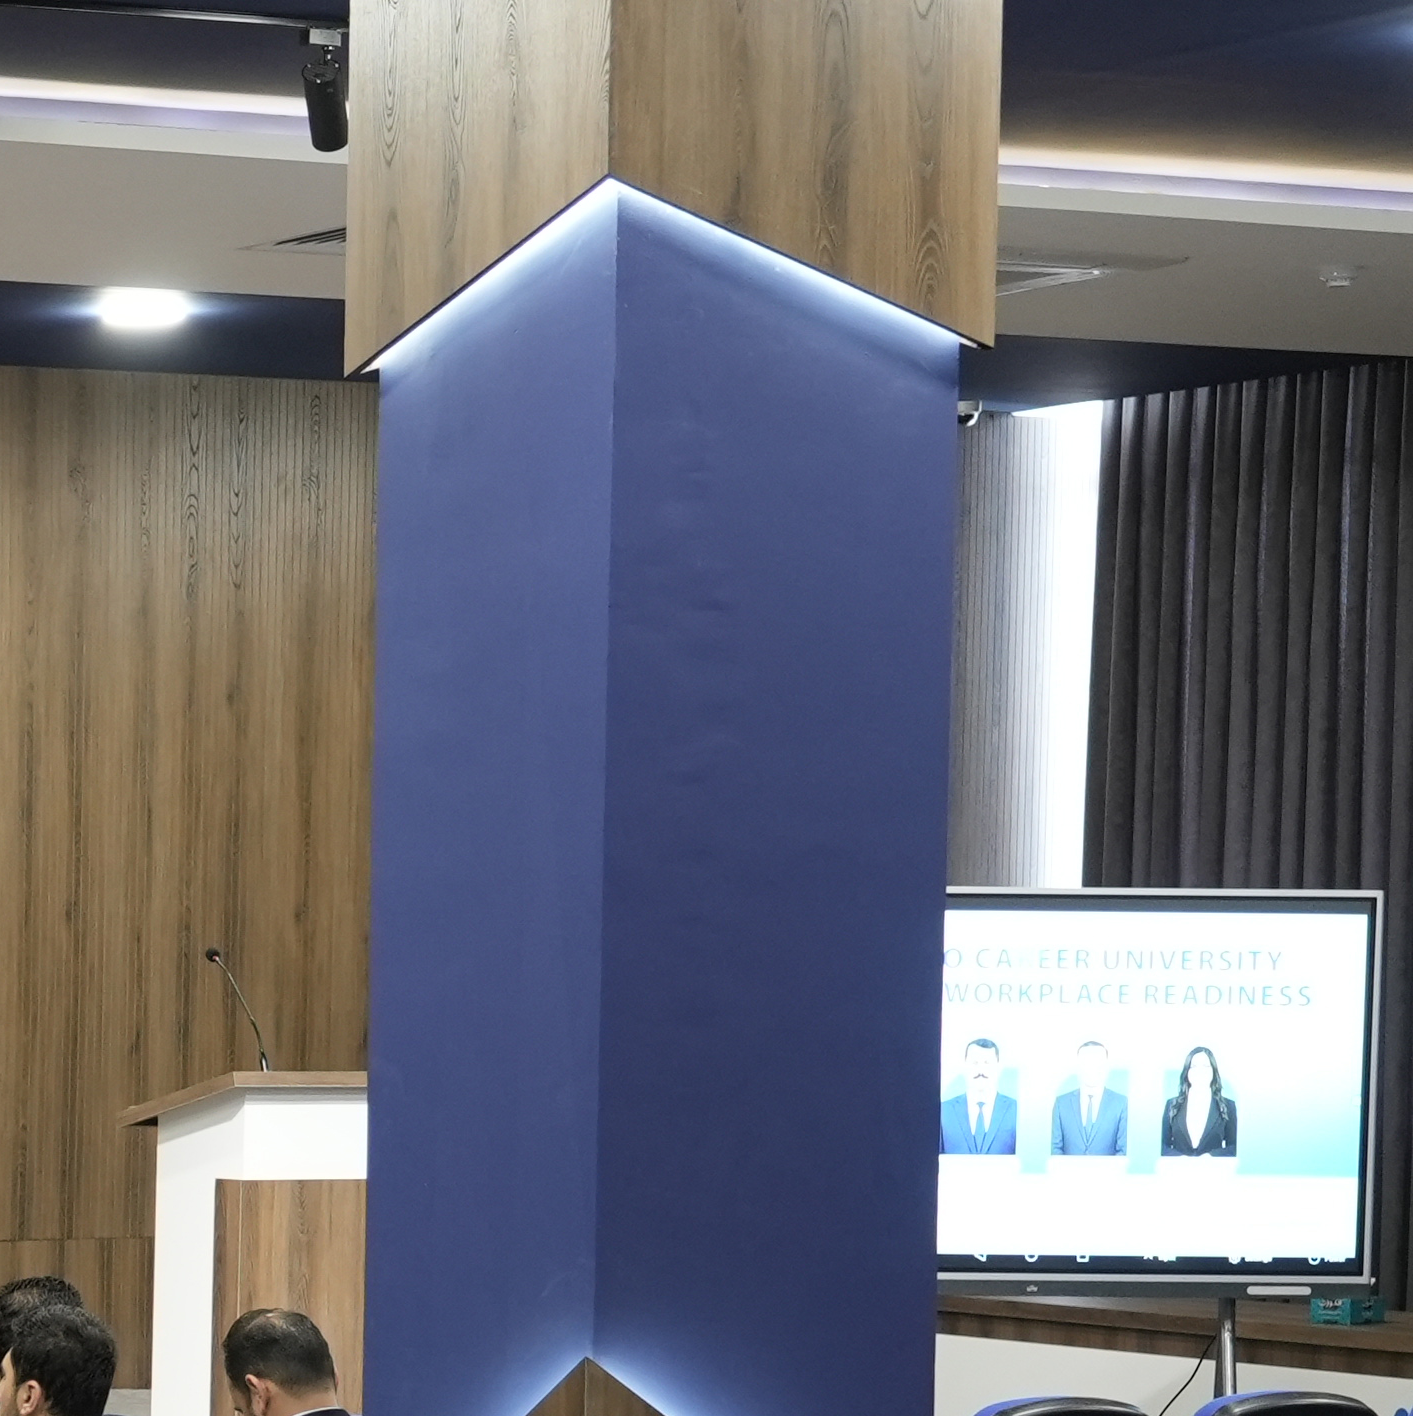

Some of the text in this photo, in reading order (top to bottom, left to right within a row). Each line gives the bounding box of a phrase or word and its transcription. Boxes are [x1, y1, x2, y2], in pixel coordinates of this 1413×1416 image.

[975, 948, 1090, 970] CAEER
[1102, 949, 1283, 971] UNIVERSITY
[944, 982, 1312, 1007] WORKPLACE READINESS
